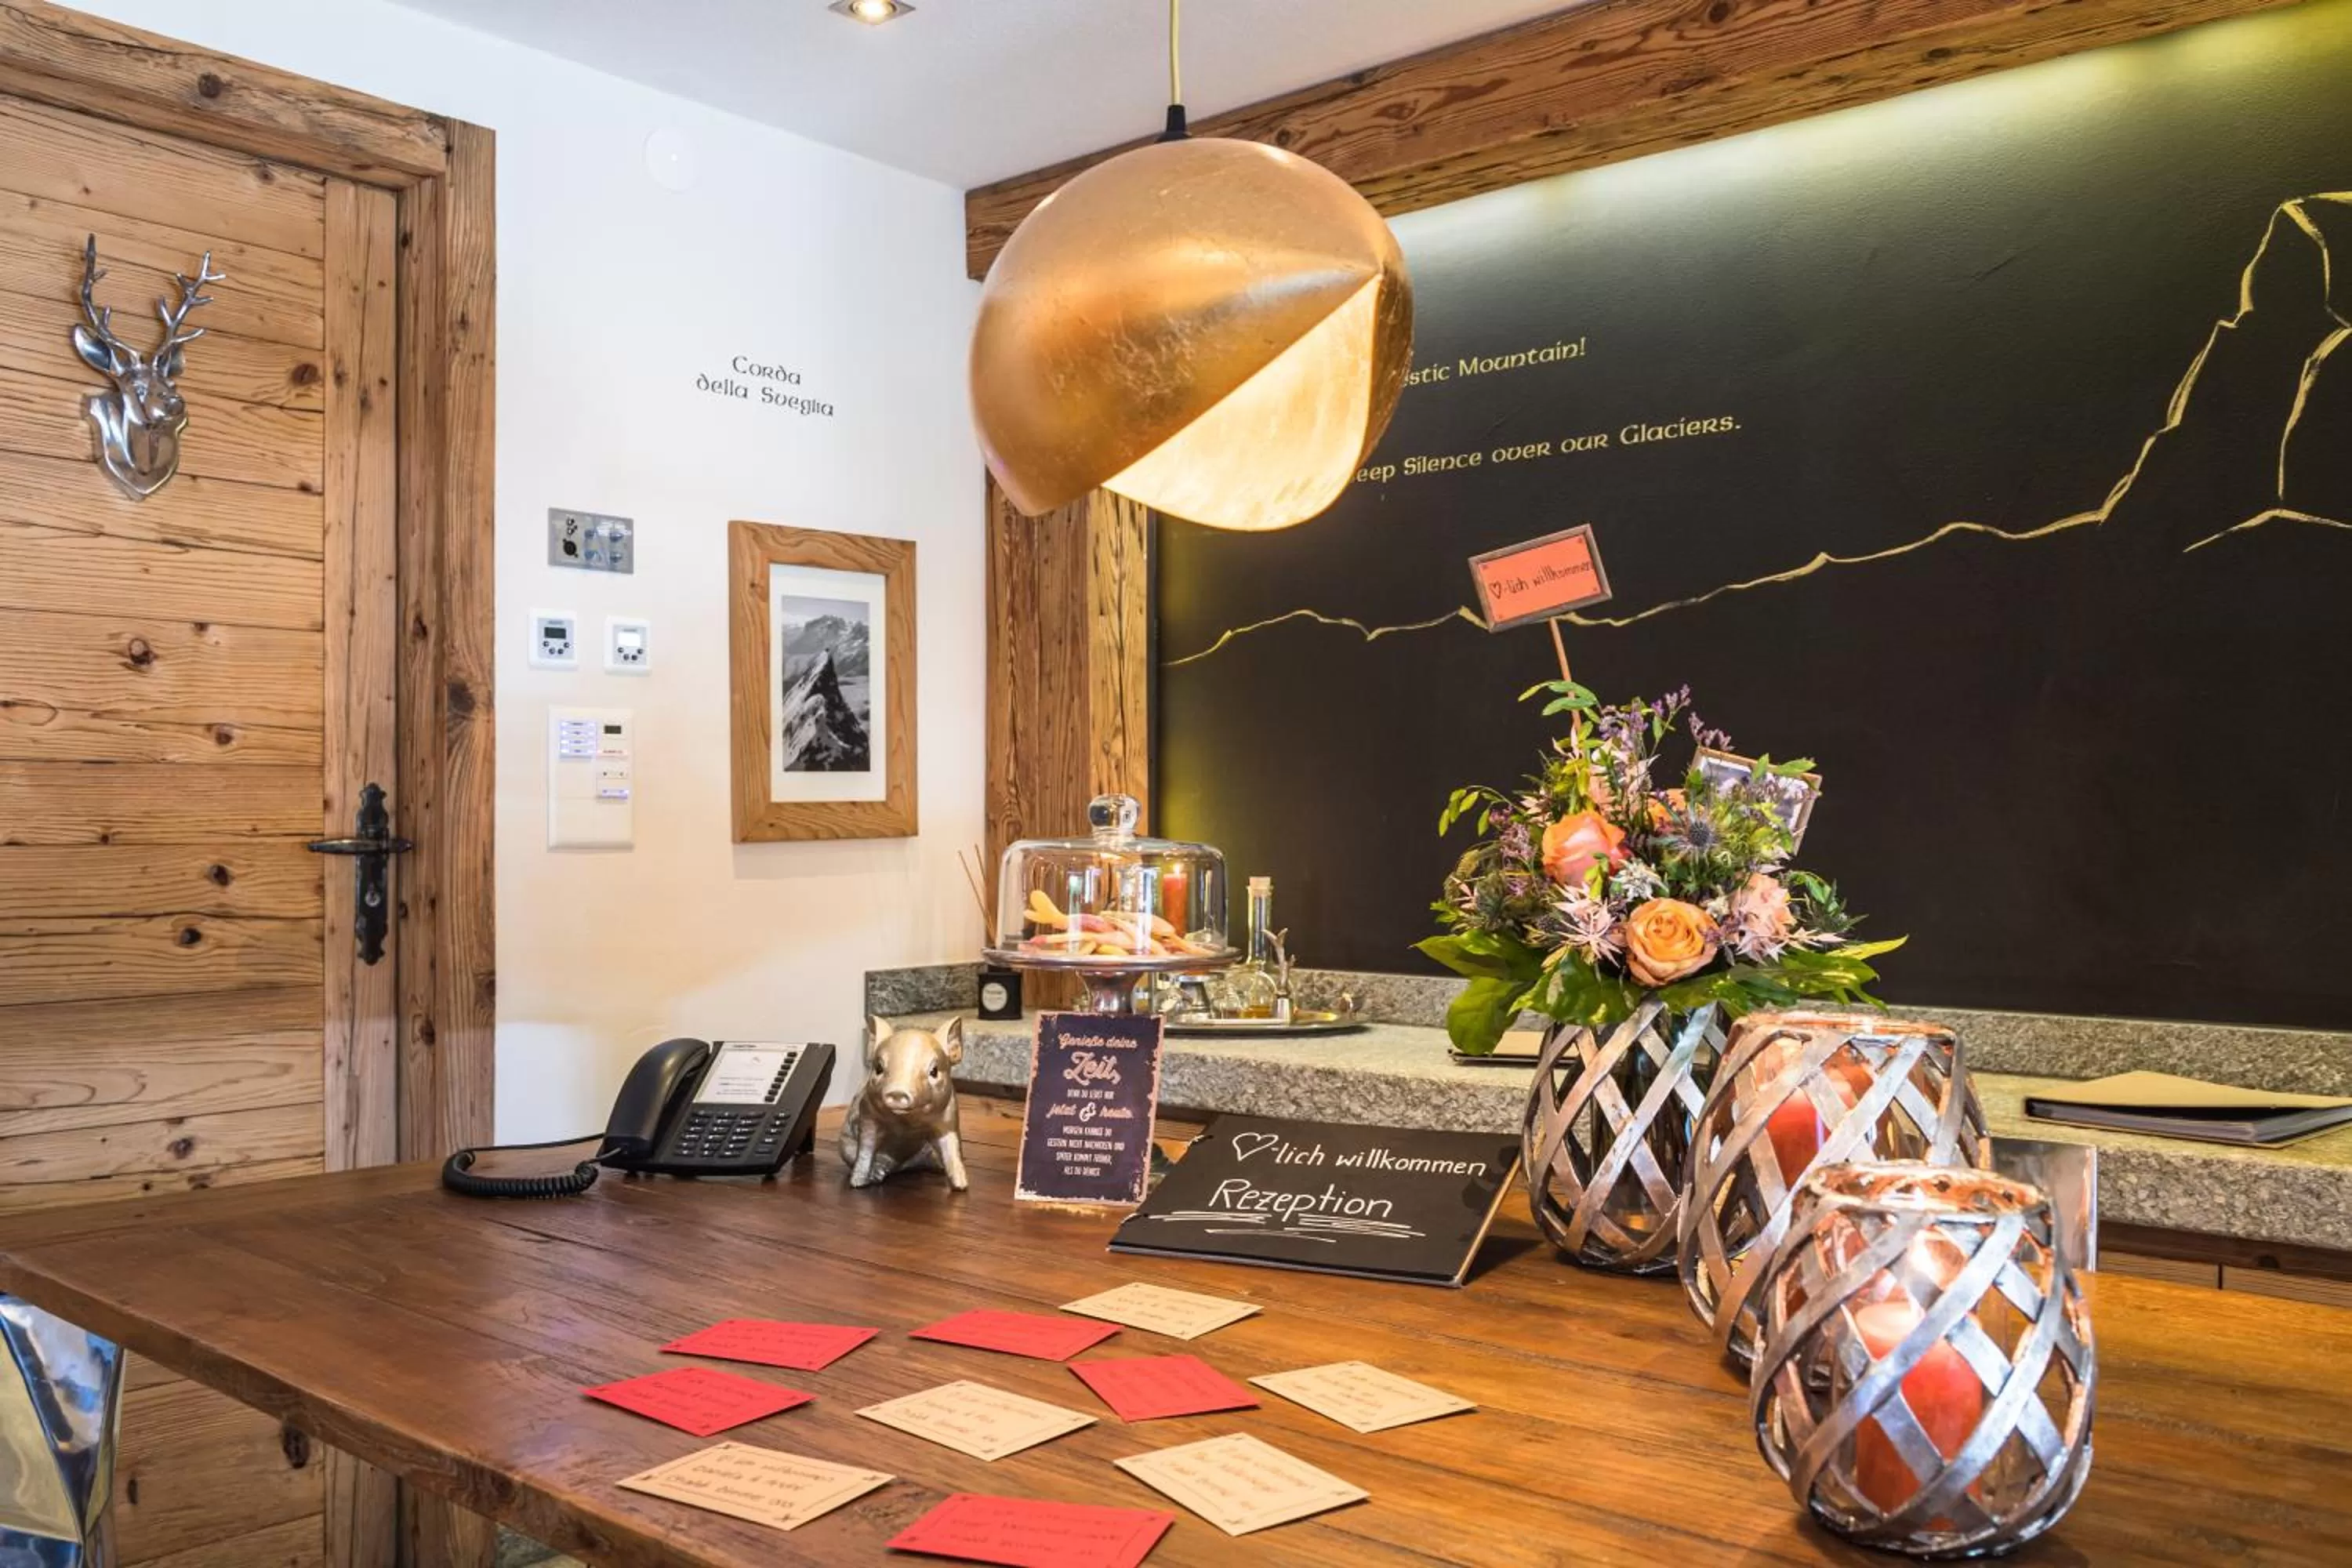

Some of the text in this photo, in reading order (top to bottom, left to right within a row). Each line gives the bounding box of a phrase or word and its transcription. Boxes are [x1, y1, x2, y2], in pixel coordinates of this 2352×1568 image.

[732, 354, 801, 385] Corda
[1458, 336, 1587, 378] Mountain!
[696, 373, 833, 416] della Sveglia
[1354, 414, 1742, 484] eep Silence over our Glaciers.
[1105, 1035, 1138, 1048] deine
[1080, 1102, 1096, 1121] &
[1335, 1148, 1486, 1177] willkommen
[1208, 1178, 1394, 1221] Rezeption
